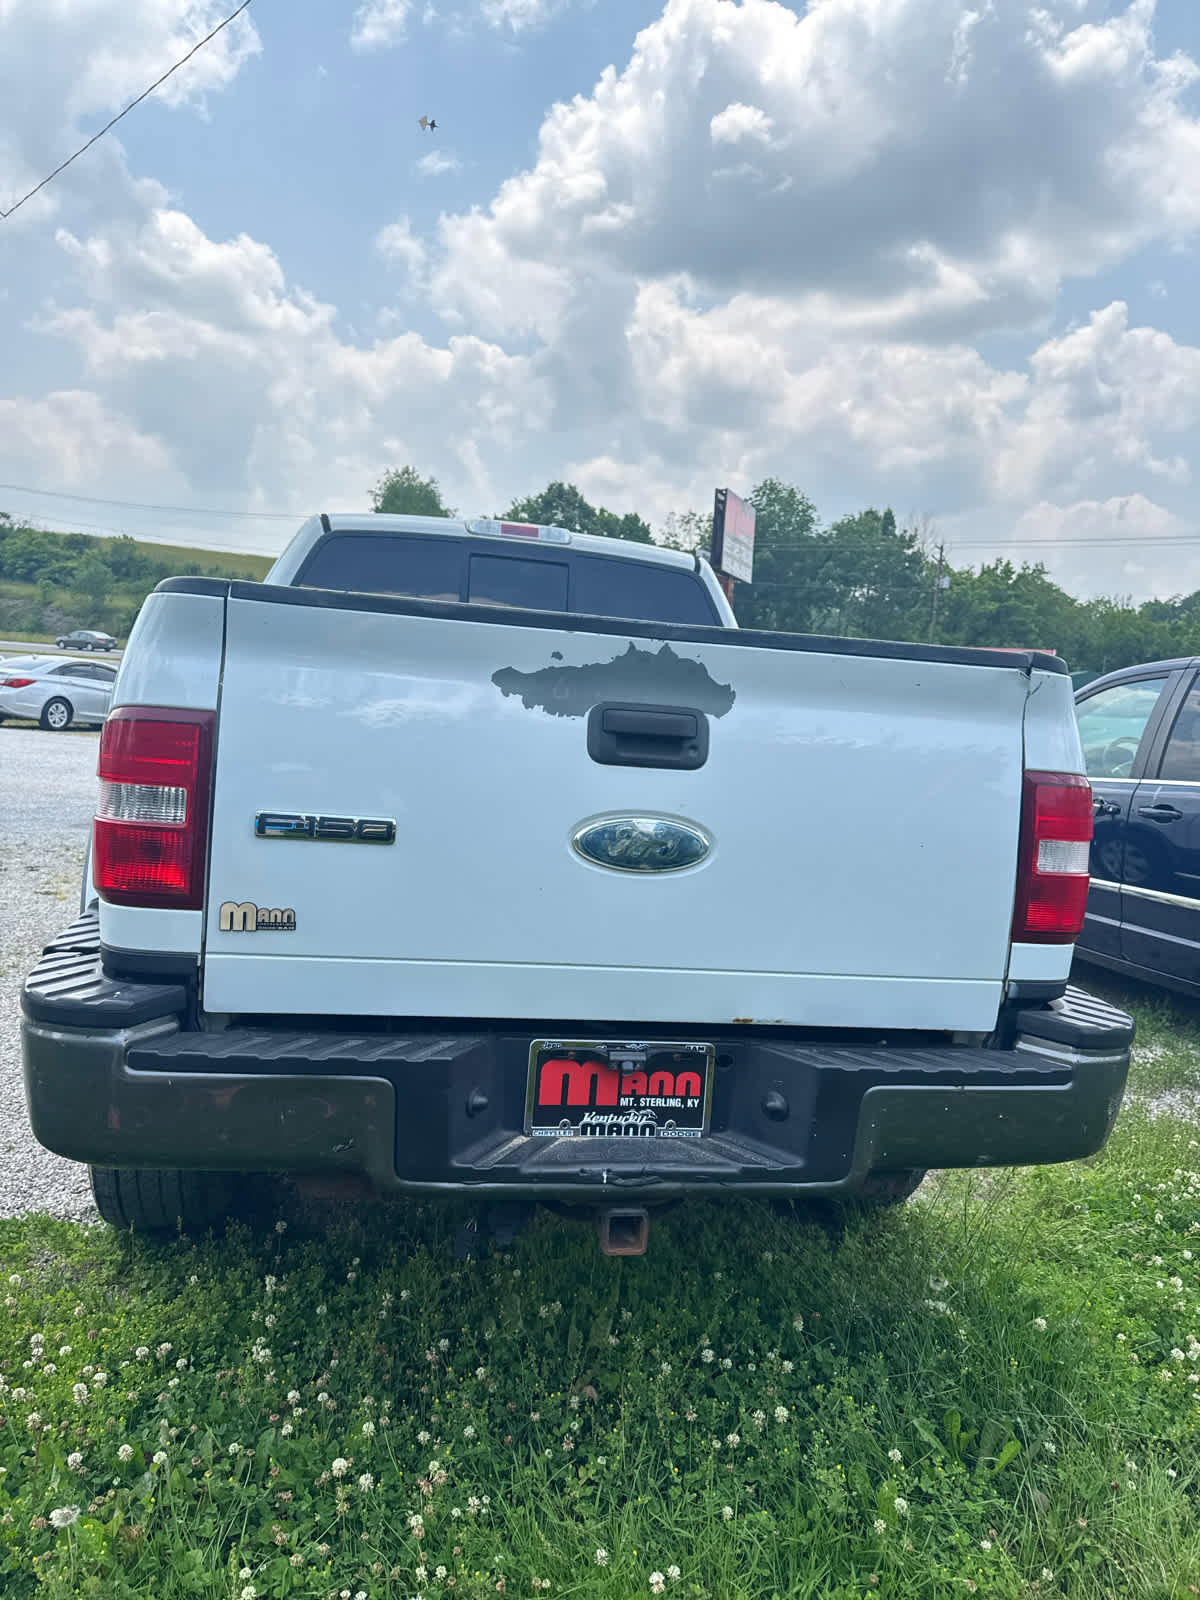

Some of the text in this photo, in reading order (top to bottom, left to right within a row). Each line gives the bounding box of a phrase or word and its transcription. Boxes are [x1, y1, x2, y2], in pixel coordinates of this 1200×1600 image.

[620, 1097, 700, 1109] MT. STERLING, KY
[582, 1111, 650, 1125] Kentucky
[661, 1130, 701, 1138] DODGE
